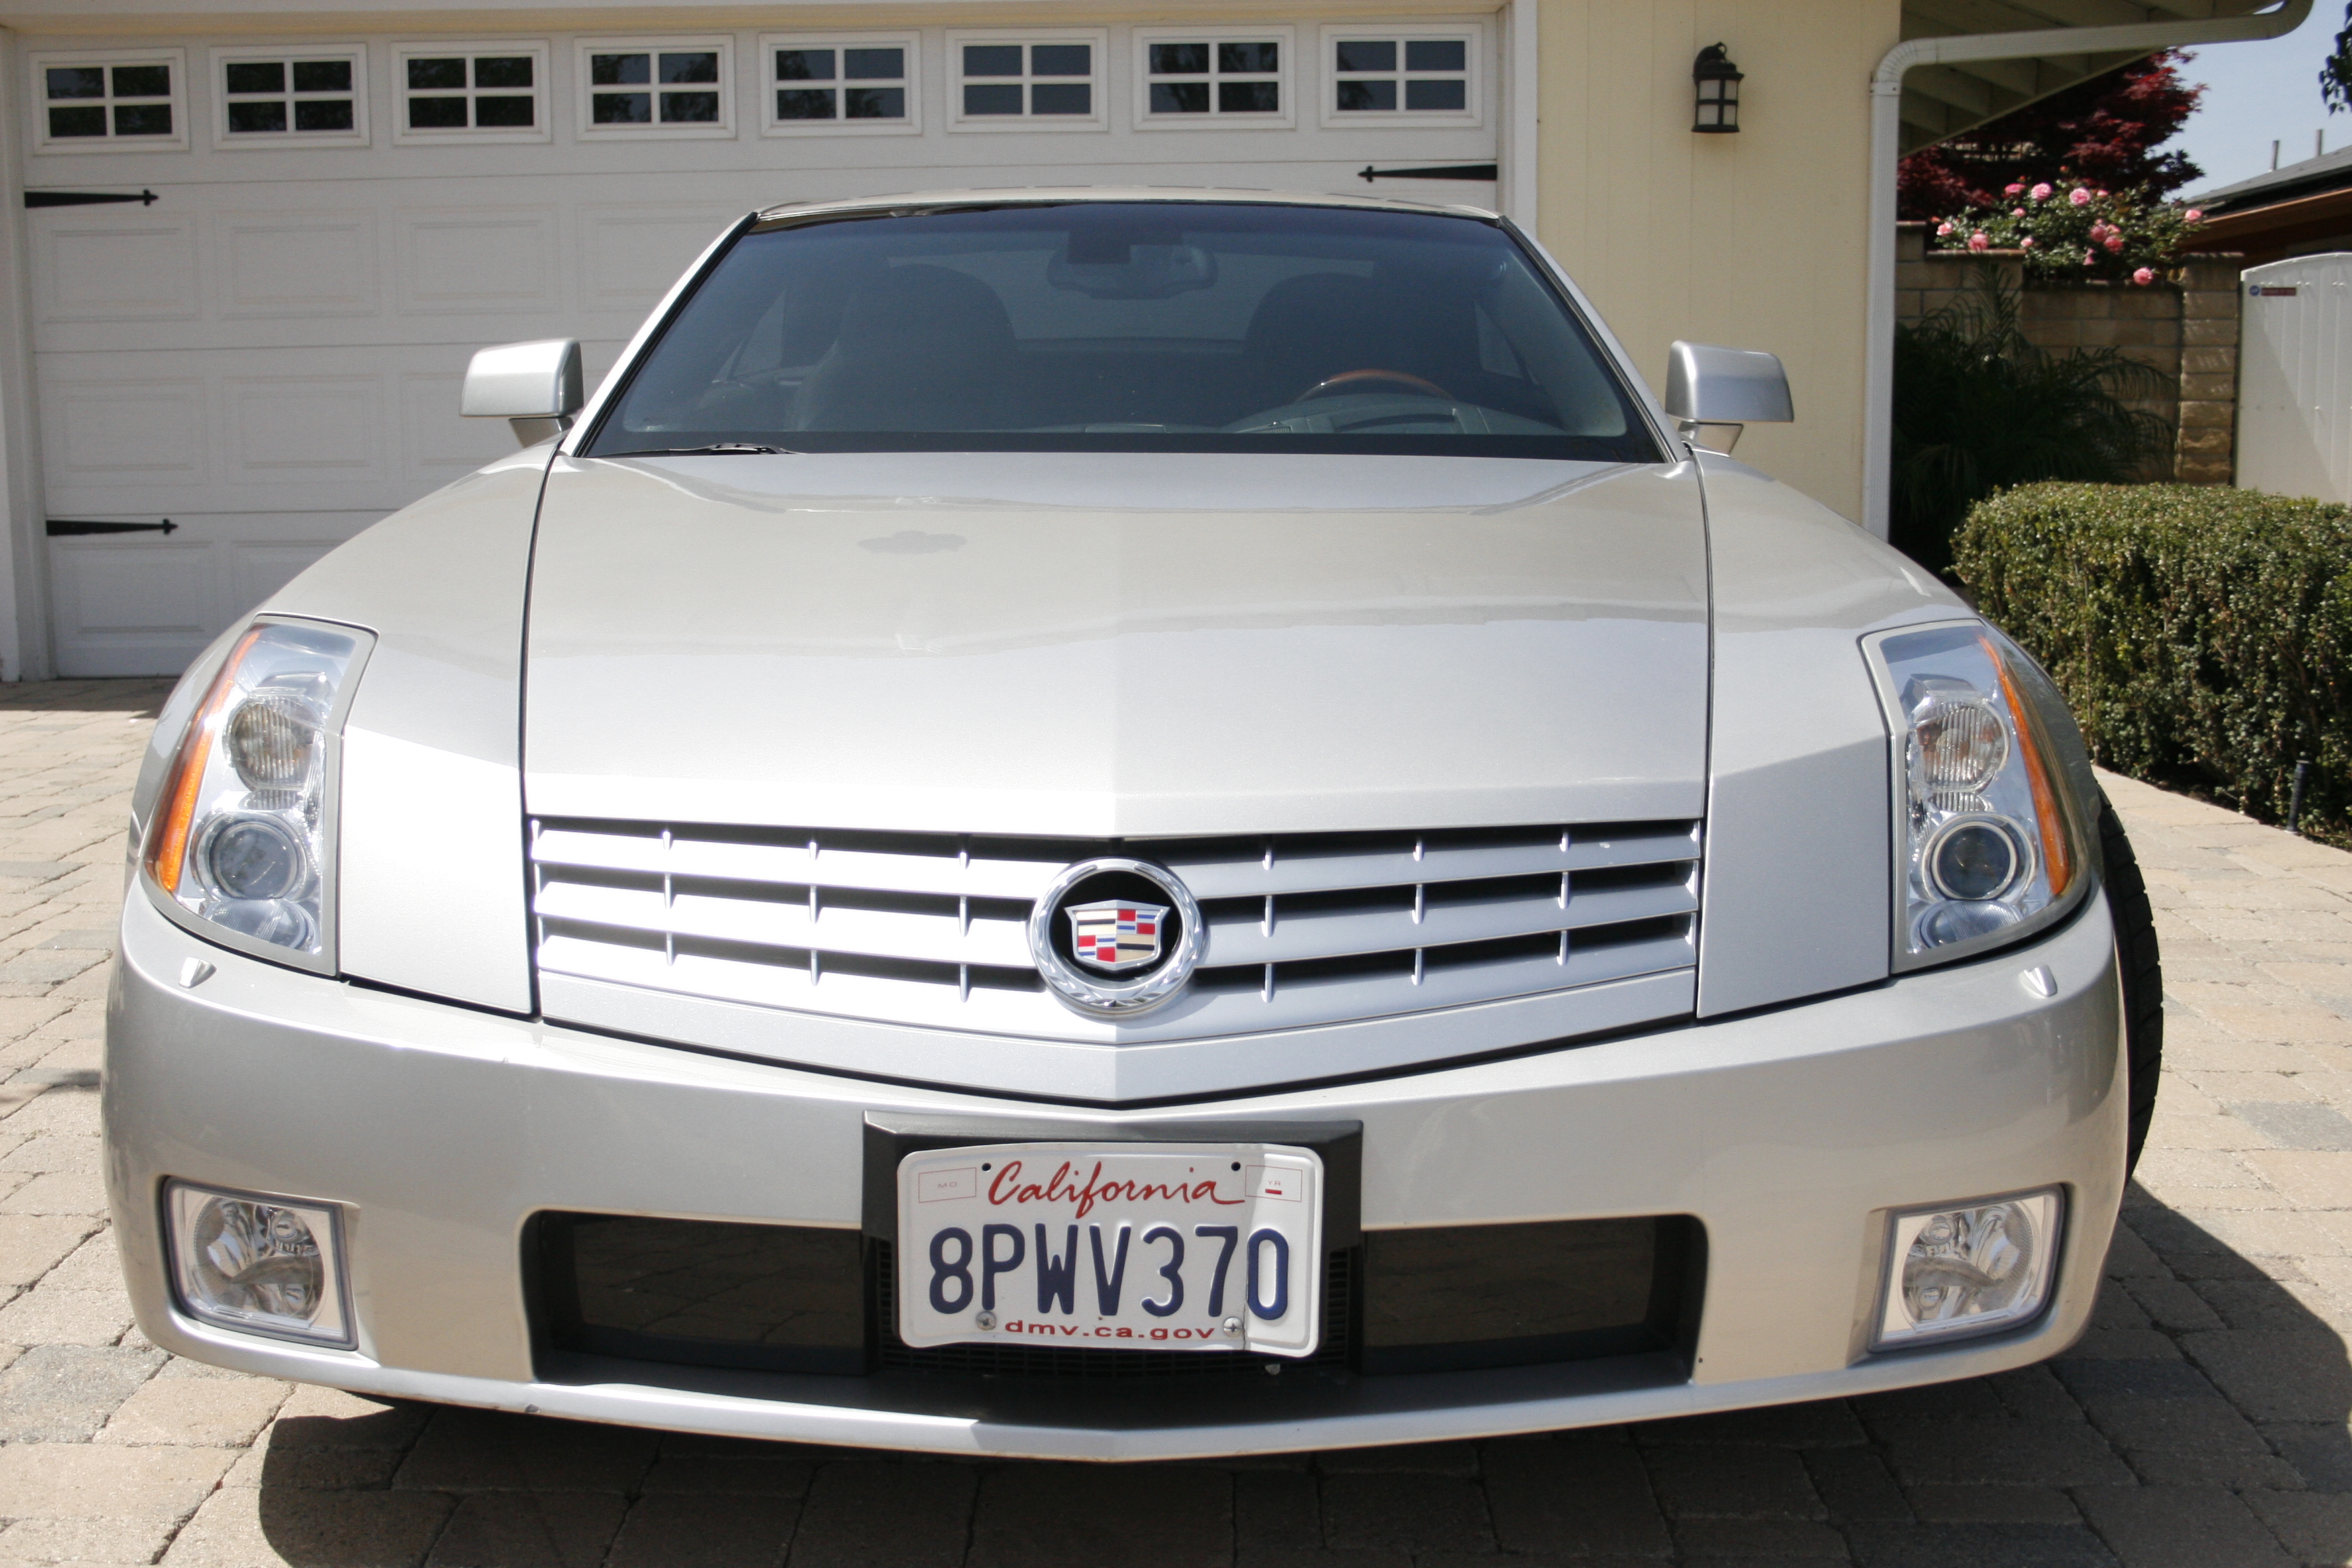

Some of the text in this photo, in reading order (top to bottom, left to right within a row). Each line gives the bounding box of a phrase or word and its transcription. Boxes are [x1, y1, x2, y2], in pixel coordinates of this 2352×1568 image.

[987, 1161, 1245, 1219] California
[928, 1223, 1289, 1321] 8PWV370
[1005, 1320, 1215, 1340] dmv.ca.gov
